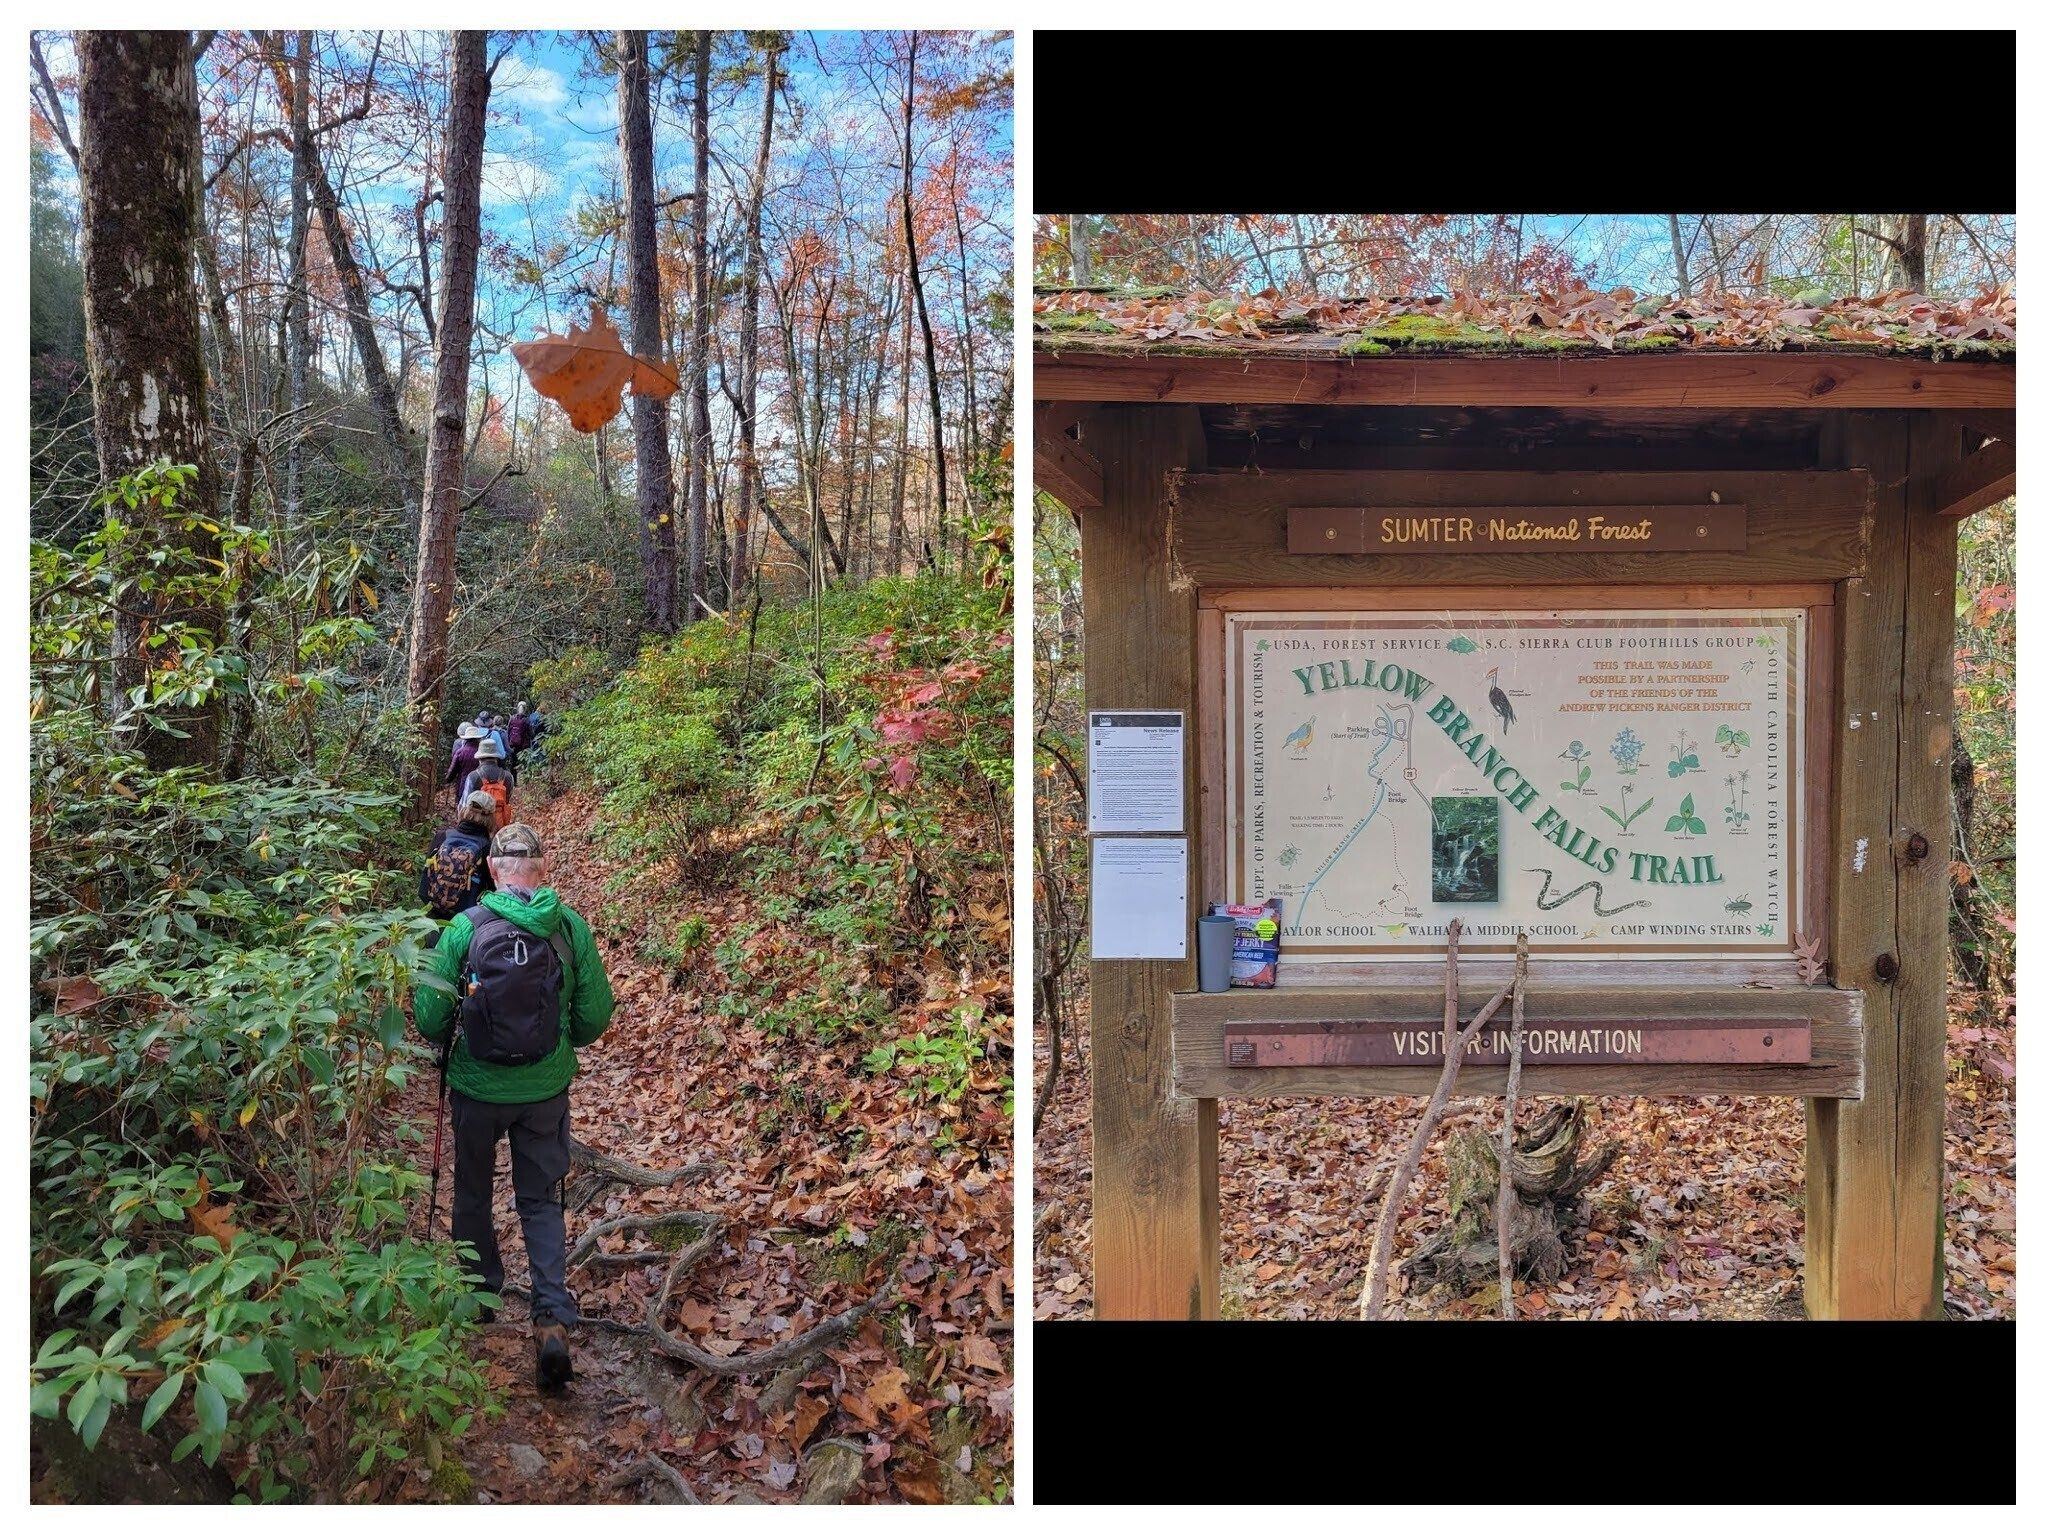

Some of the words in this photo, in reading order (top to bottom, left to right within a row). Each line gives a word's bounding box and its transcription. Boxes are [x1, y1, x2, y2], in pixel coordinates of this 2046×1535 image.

[1381, 518, 1474, 543] SUMTER
[1489, 517, 1581, 542] National
[1588, 516, 1652, 541] Forest
[1274, 640, 1315, 651] USDA,
[1323, 640, 1376, 650] FOREST
[1382, 639, 1441, 650] SERVICE
[1485, 638, 1513, 649] S.C.
[1519, 638, 1570, 649] SIERRA
[1577, 638, 1612, 649] CLUB
[1619, 637, 1699, 649] FOOTHILLS
[1705, 636, 1754, 648] GROUP
[1593, 661, 1619, 670] THIS
[1624, 661, 1655, 670] TRAIL
[1657, 661, 1679, 670] WAS
[1681, 661, 1713, 670] MADE
[1253, 652, 1264, 706] TOURISM
[1578, 675, 1627, 684] POSSIBLE
[1630, 675, 1645, 684] BY
[1647, 675, 1654, 684] A
[1657, 675, 1730, 684] PARTNERSHIP
[1767, 649, 1778, 702] SOUTH
[1590, 689, 1605, 698] OF
[1607, 689, 1629, 698] THE
[1631, 689, 1677, 698] FRIENDS
[1679, 689, 1694, 698] OF
[1696, 689, 1718, 698] THE
[1254, 710, 1264, 719] &
[1558, 702, 1606, 712] ANDREW
[1609, 702, 1655, 712] PICKENS
[1657, 702, 1701, 712] RANGER
[1703, 702, 1752, 712] DISTRICT
[1767, 710, 1778, 792] CAROLINA
[1254, 723, 1264, 797] RECREATION
[1292, 658, 1434, 702] YELLOW
[1426, 694, 1540, 813] BRANCH
[1531, 805, 1619, 874] FALLS
[1629, 851, 1723, 884] TRAIL
[1254, 801, 1266, 842] PARKS,
[1767, 800, 1778, 860] FOREST
[1254, 845, 1264, 862] OF
[1254, 866, 1265, 899] DEPT.
[1269, 889, 1294, 897] Viewing
[1767, 869, 1778, 923] WATCH
[1282, 926, 1322, 937] AYLOR
[1326, 926, 1376, 937] SCHOOL
[1408, 925, 1472, 936] WALHAA
[1477, 925, 1524, 936] MIDDLE
[1529, 925, 1579, 936] SCHOOL
[1611, 925, 1645, 936] CAMP
[1649, 925, 1706, 936] WINDING
[1710, 925, 1752, 936] STAIRS
[1393, 1030, 1482, 1056] VISITR
